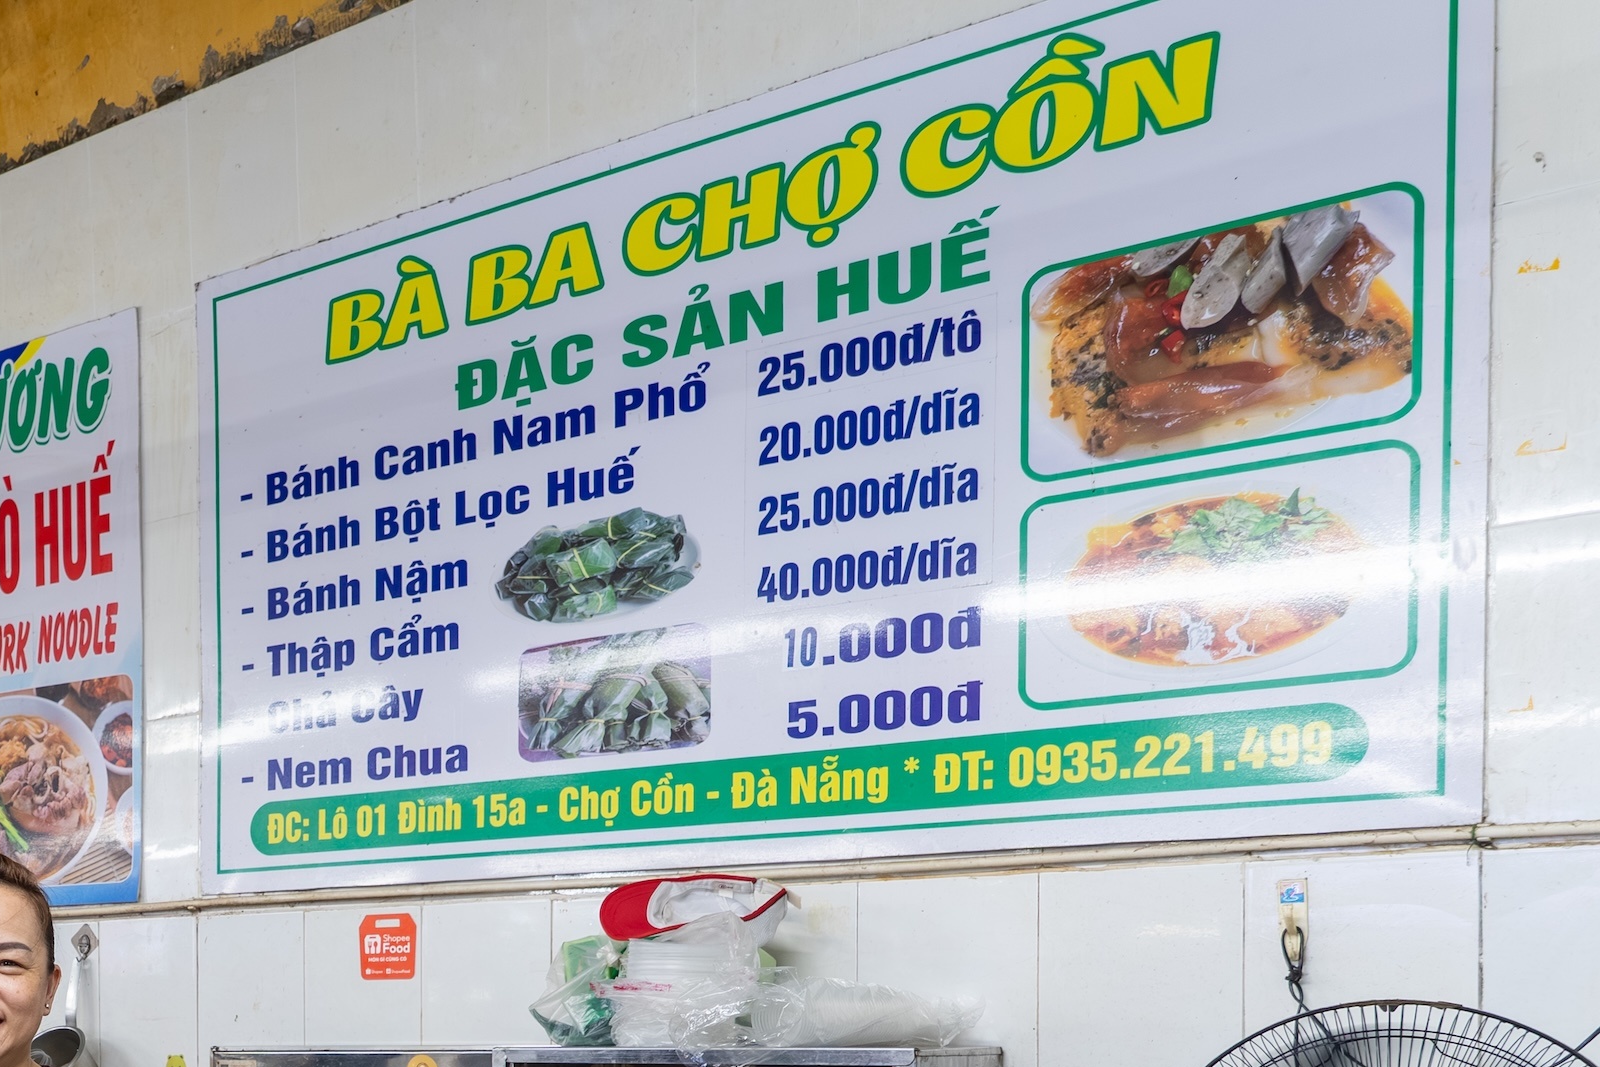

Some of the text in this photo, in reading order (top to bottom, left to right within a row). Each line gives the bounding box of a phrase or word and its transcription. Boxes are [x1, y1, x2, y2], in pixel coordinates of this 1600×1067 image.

[325, 31, 1221, 365] BÀ BA CHỢ CỒN
[455, 205, 1000, 409] ĐẶC SẢN HUẾ
[758, 309, 982, 397] 25.000đ/tô
[266, 361, 711, 506] Bánh Canh Nam Phổ
[758, 387, 980, 466] 20.000đ/dĩa
[34, 440, 116, 587] HUẾ
[267, 447, 642, 564] Bánh Bột Lọc Huế
[758, 462, 978, 536] 25.000đ/dĩa
[267, 558, 469, 621] Bánh Nậm
[757, 536, 978, 603] 40.000đ/dĩa
[38, 602, 119, 665] NOODLE
[267, 614, 460, 680] Thập Cẩm
[784, 606, 984, 668] 10.000đ
[267, 684, 423, 736] Chả Cây
[786, 680, 984, 739] 5.000đ
[267, 742, 469, 791] Nem Chua
[267, 721, 1334, 846] ĐC: Lô 01 Đình 15a Chợ Cồn Đà Nẵng ĐT: 0935.221.499
[382, 934, 410, 944] Shopee
[382, 942, 410, 954] Food
